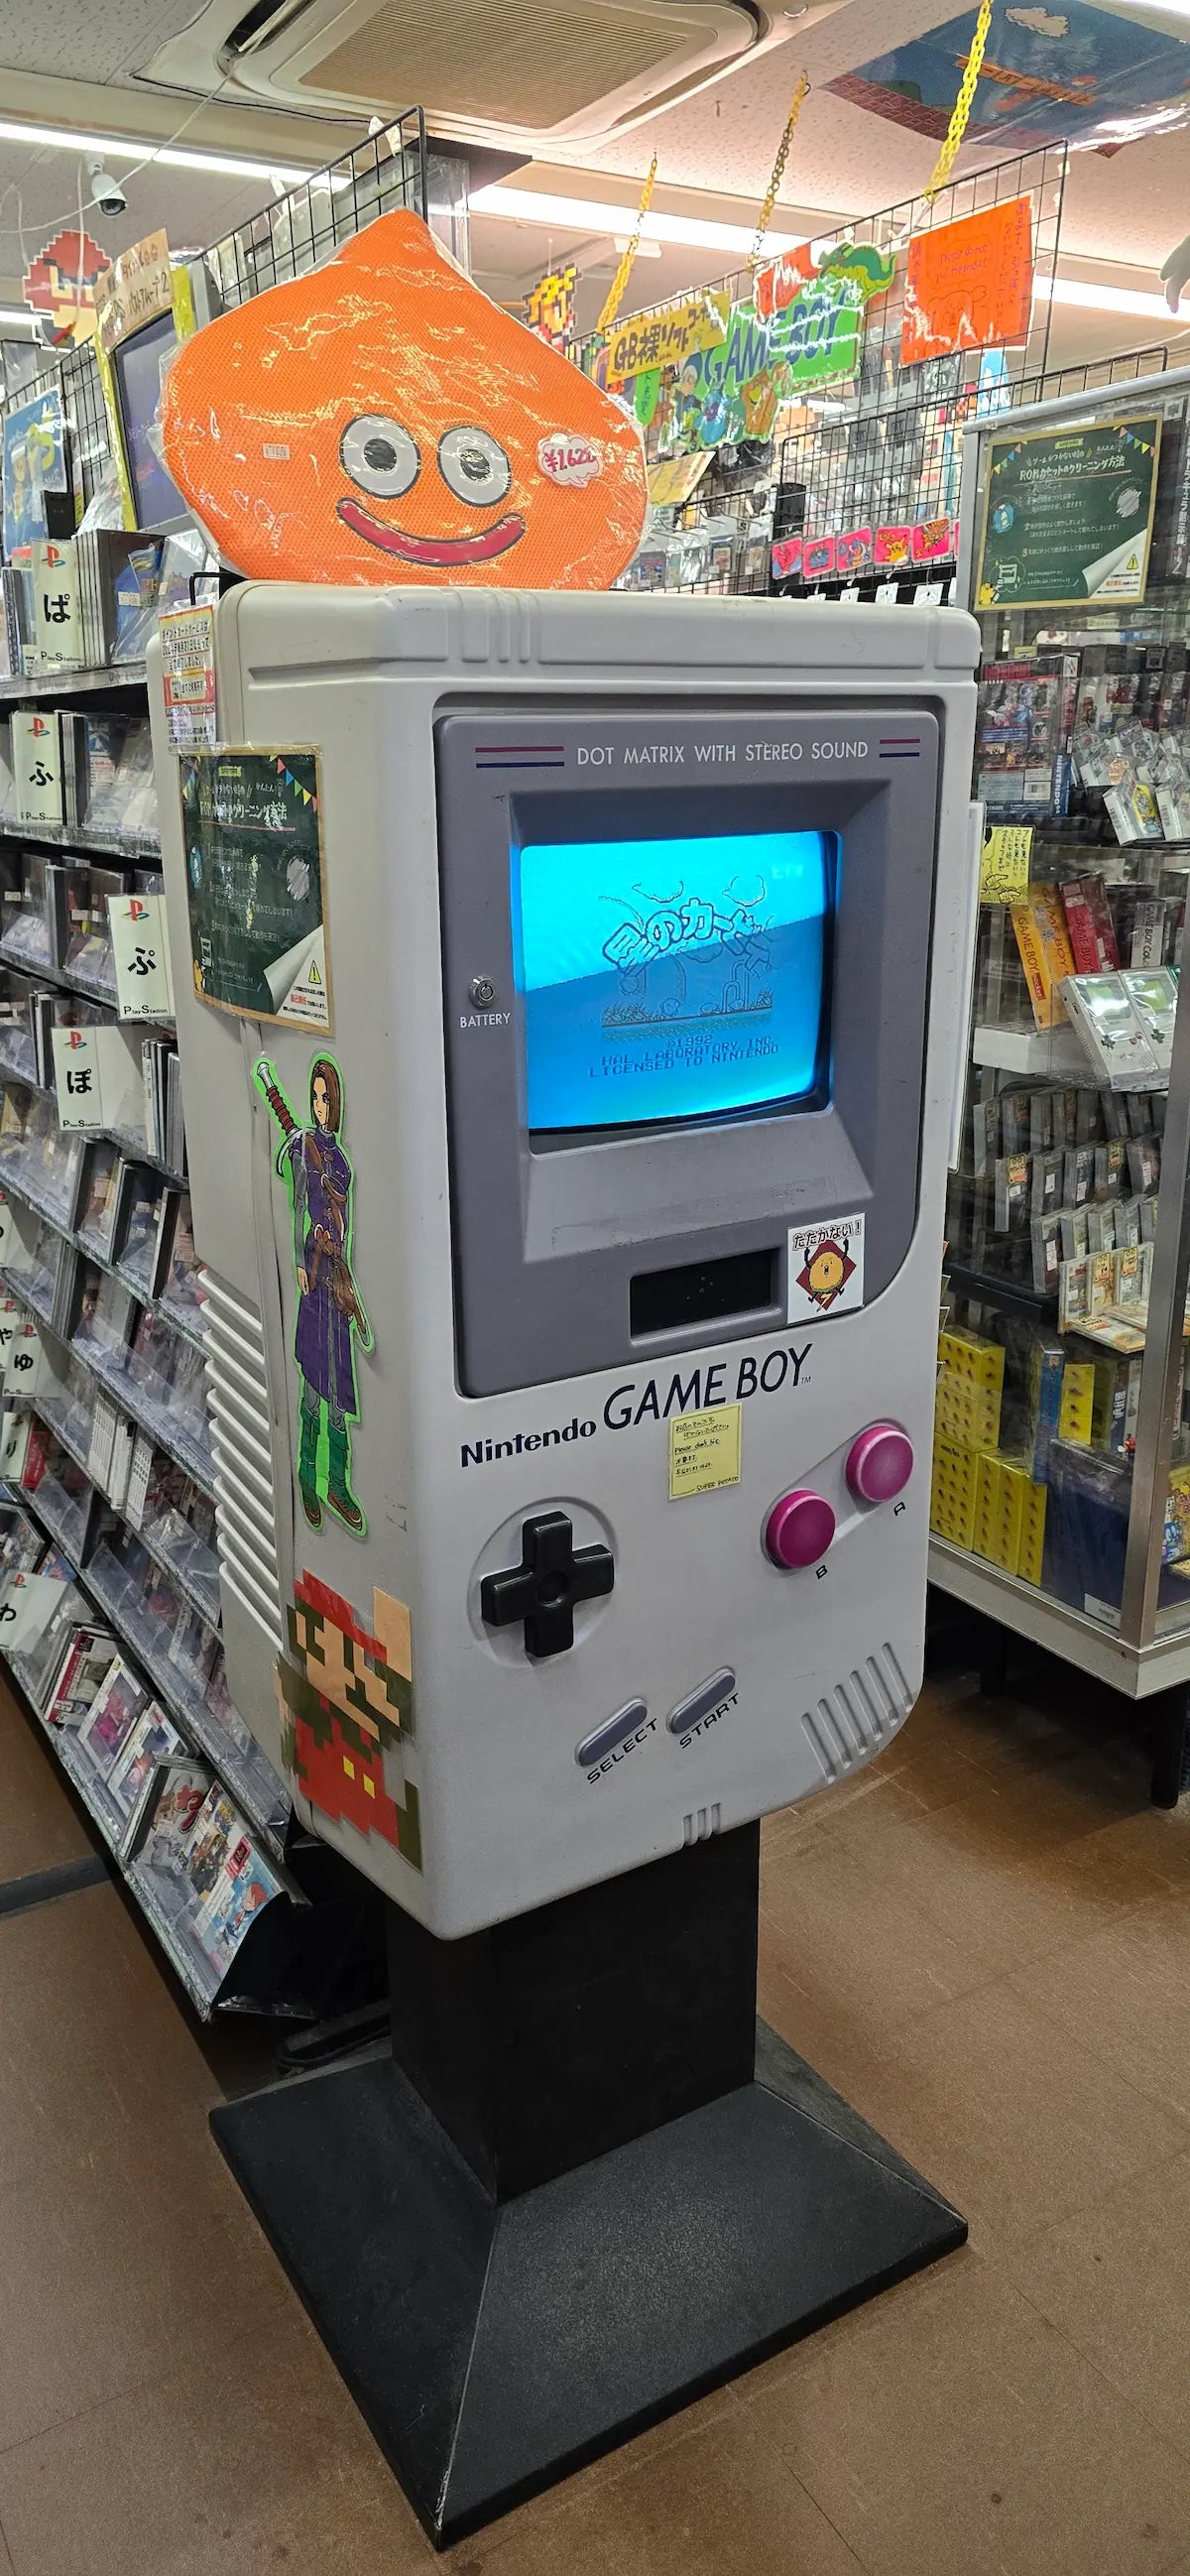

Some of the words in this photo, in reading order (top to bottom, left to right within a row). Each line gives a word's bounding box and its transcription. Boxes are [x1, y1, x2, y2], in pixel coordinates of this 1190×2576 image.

[44, 593, 71, 624] ぱ
[577, 746, 615, 766] DOT
[623, 745, 685, 765] MATRIX
[694, 744, 736, 763] WITH
[745, 742, 803, 762] STEREO
[811, 741, 869, 760] SOUND
[29, 761, 55, 787] ふ
[1018, 917, 1034, 950] GAME
[127, 946, 157, 976] ぷ
[1025, 949, 1039, 972] BOY
[123, 1004, 169, 1016] PlayStation
[459, 1012, 511, 1029] BATTERY
[589, 1058, 674, 1078] LICENSED
[685, 1056, 703, 1068] TO
[711, 1044, 778, 1064] NINTENDO
[601, 1054, 634, 1066] HAL
[646, 1041, 738, 1061] LABORATORY
[66, 1068, 92, 1094] ぽ
[793, 1219, 862, 1251] たたかない！
[14, 1354, 34, 1371] ゆ
[460, 1417, 597, 1468] Nintendo
[603, 1363, 727, 1431] GAME
[736, 1343, 813, 1400] BOY
[893, 1501, 906, 1517] A
[815, 1564, 828, 1580] B
[587, 1717, 657, 1784] SELECT
[679, 1692, 739, 1749] START
